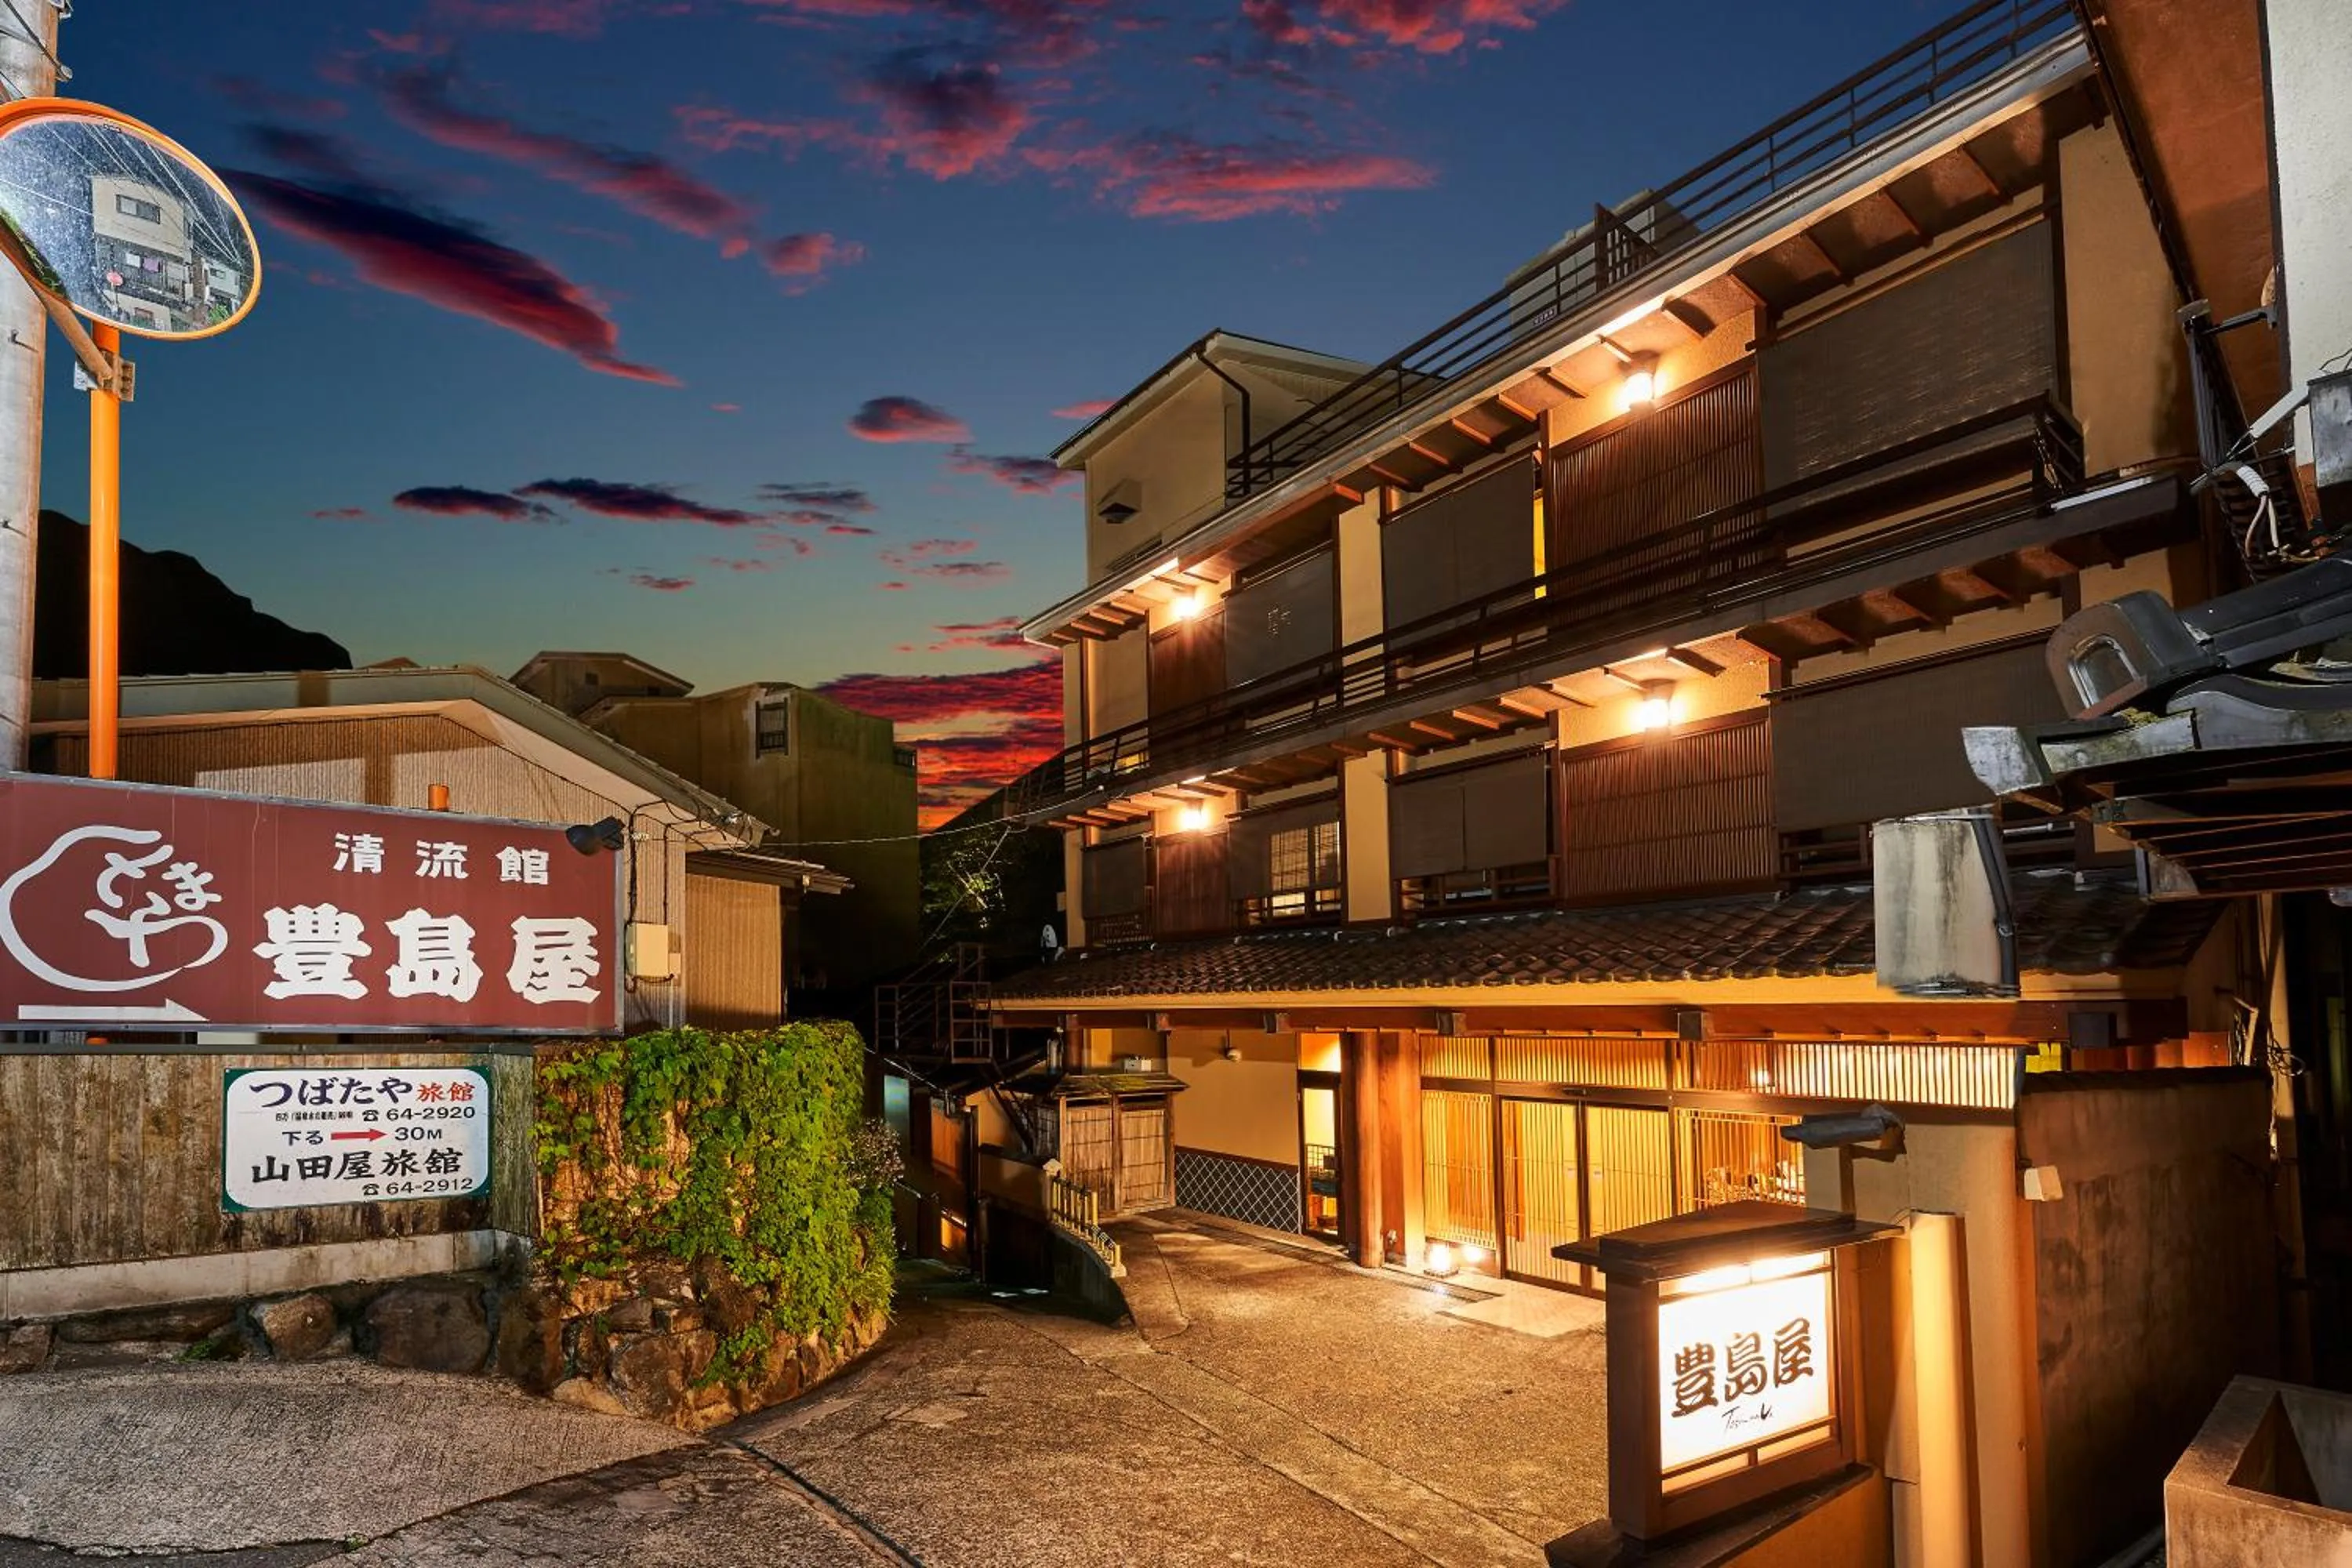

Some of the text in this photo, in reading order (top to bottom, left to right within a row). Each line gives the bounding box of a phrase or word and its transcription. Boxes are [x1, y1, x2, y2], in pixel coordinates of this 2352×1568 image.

[333, 832, 550, 885] 清流館
[386, 1106, 476, 1121] 64-2920
[281, 1127, 442, 1145] 下る 30M
[386, 1178, 474, 1196] 64-2912
